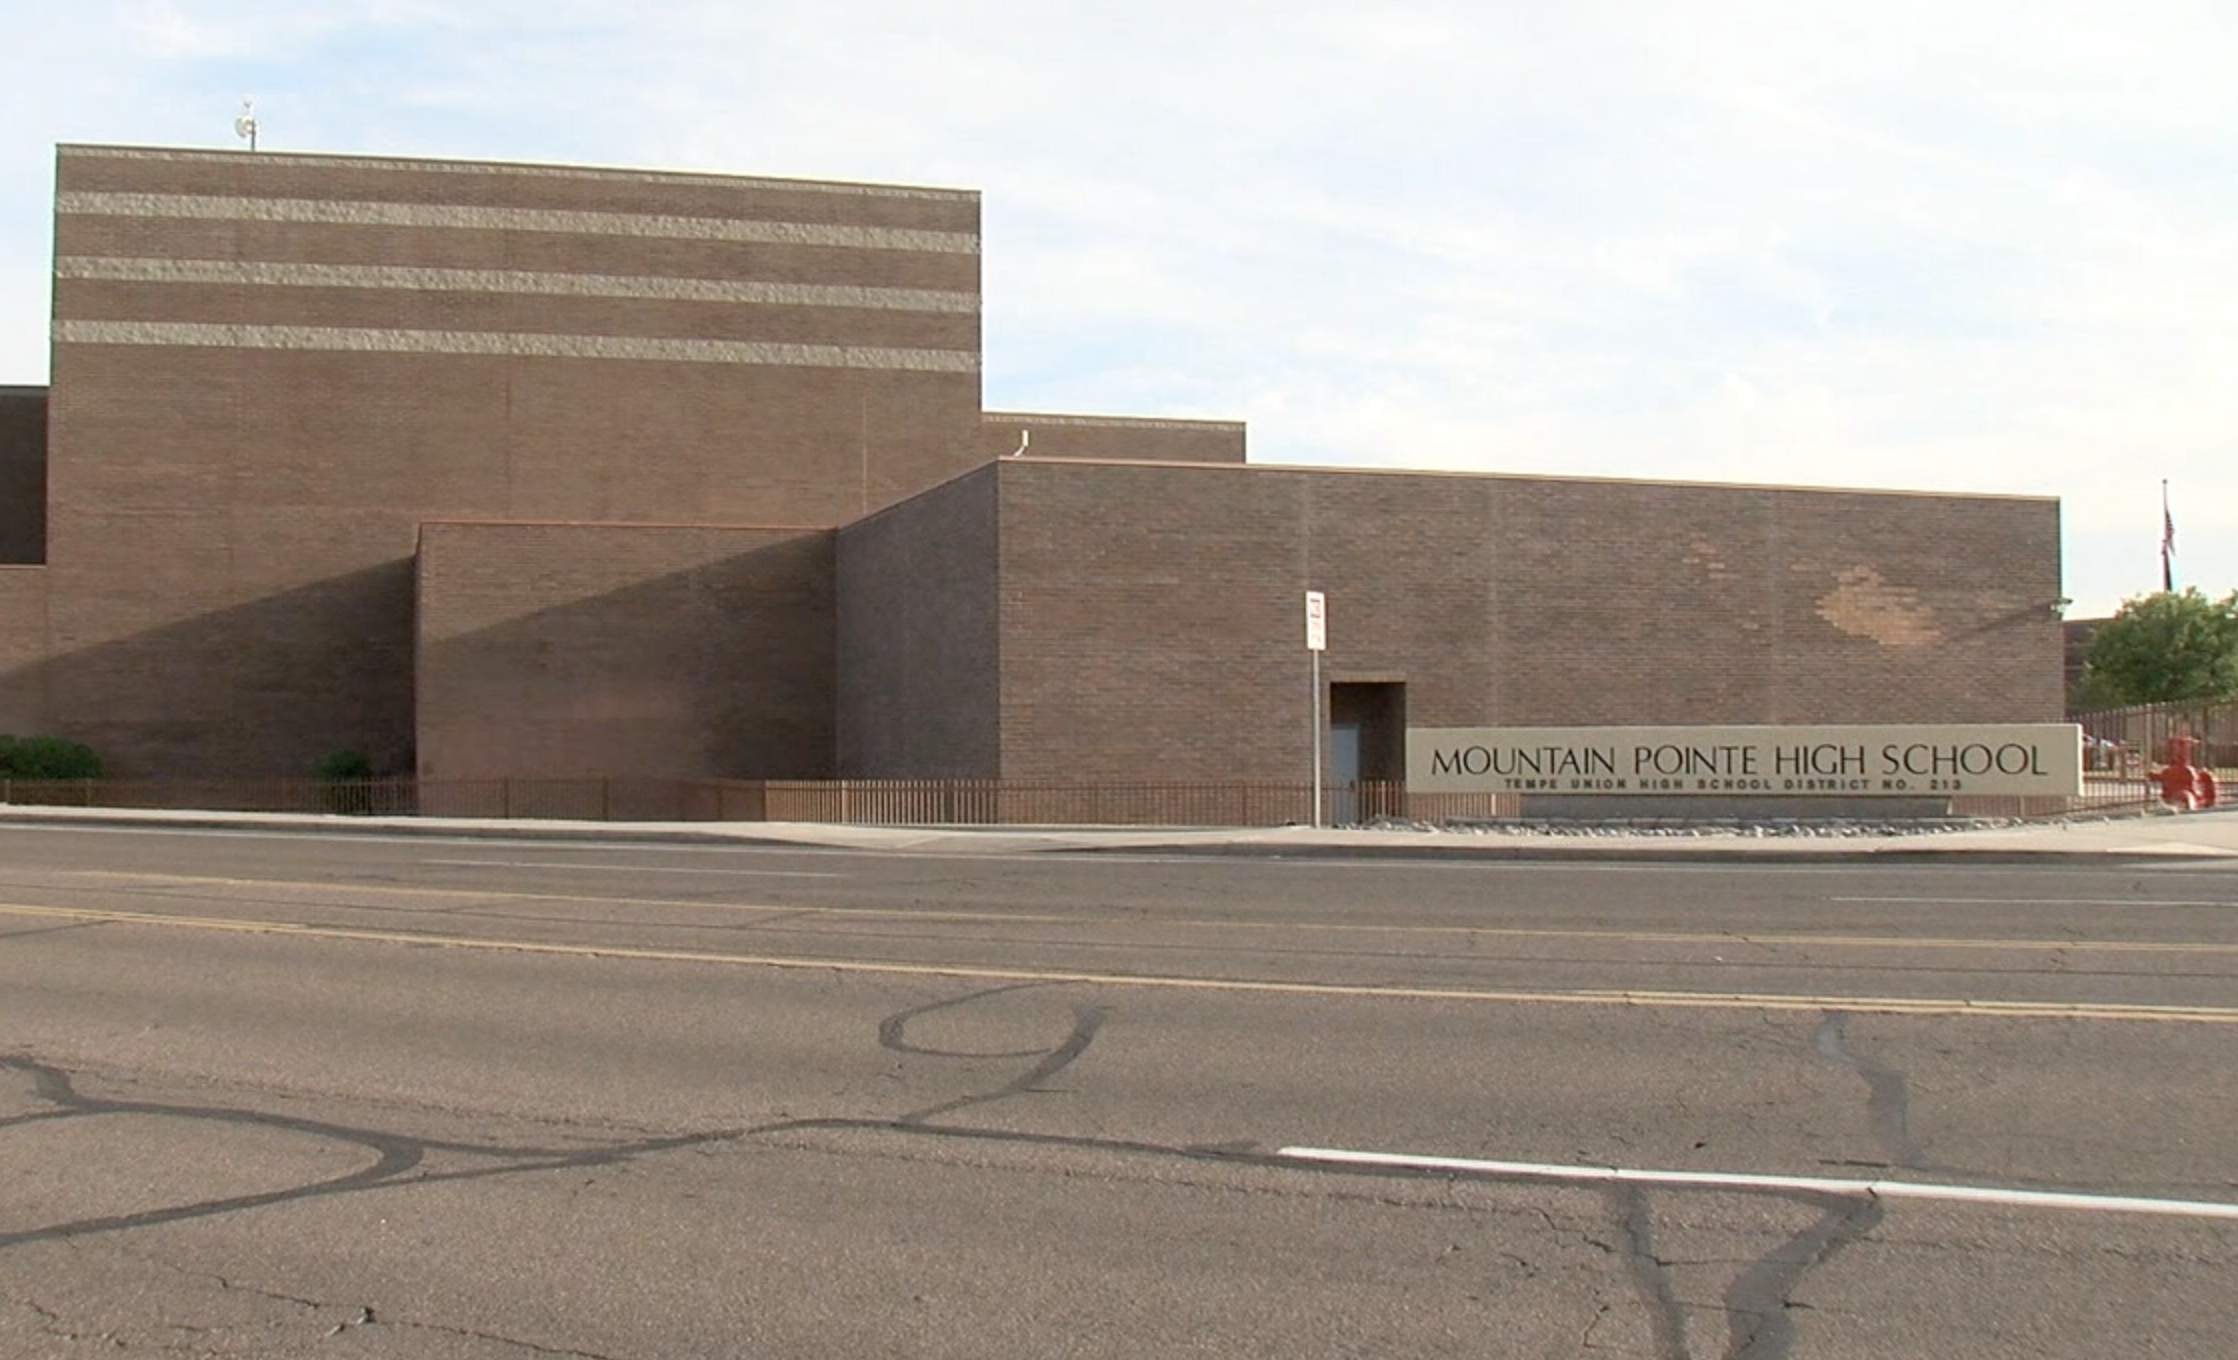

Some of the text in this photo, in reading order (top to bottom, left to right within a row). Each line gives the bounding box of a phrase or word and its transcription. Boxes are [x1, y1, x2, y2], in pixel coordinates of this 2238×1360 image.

[1431, 743, 2048, 775] MOUNTAIN POINTE HIGH SCHOOL
[1504, 778, 1963, 790] TEMPE UNION HIGH SCHOOL DISTRICT NO. 213
